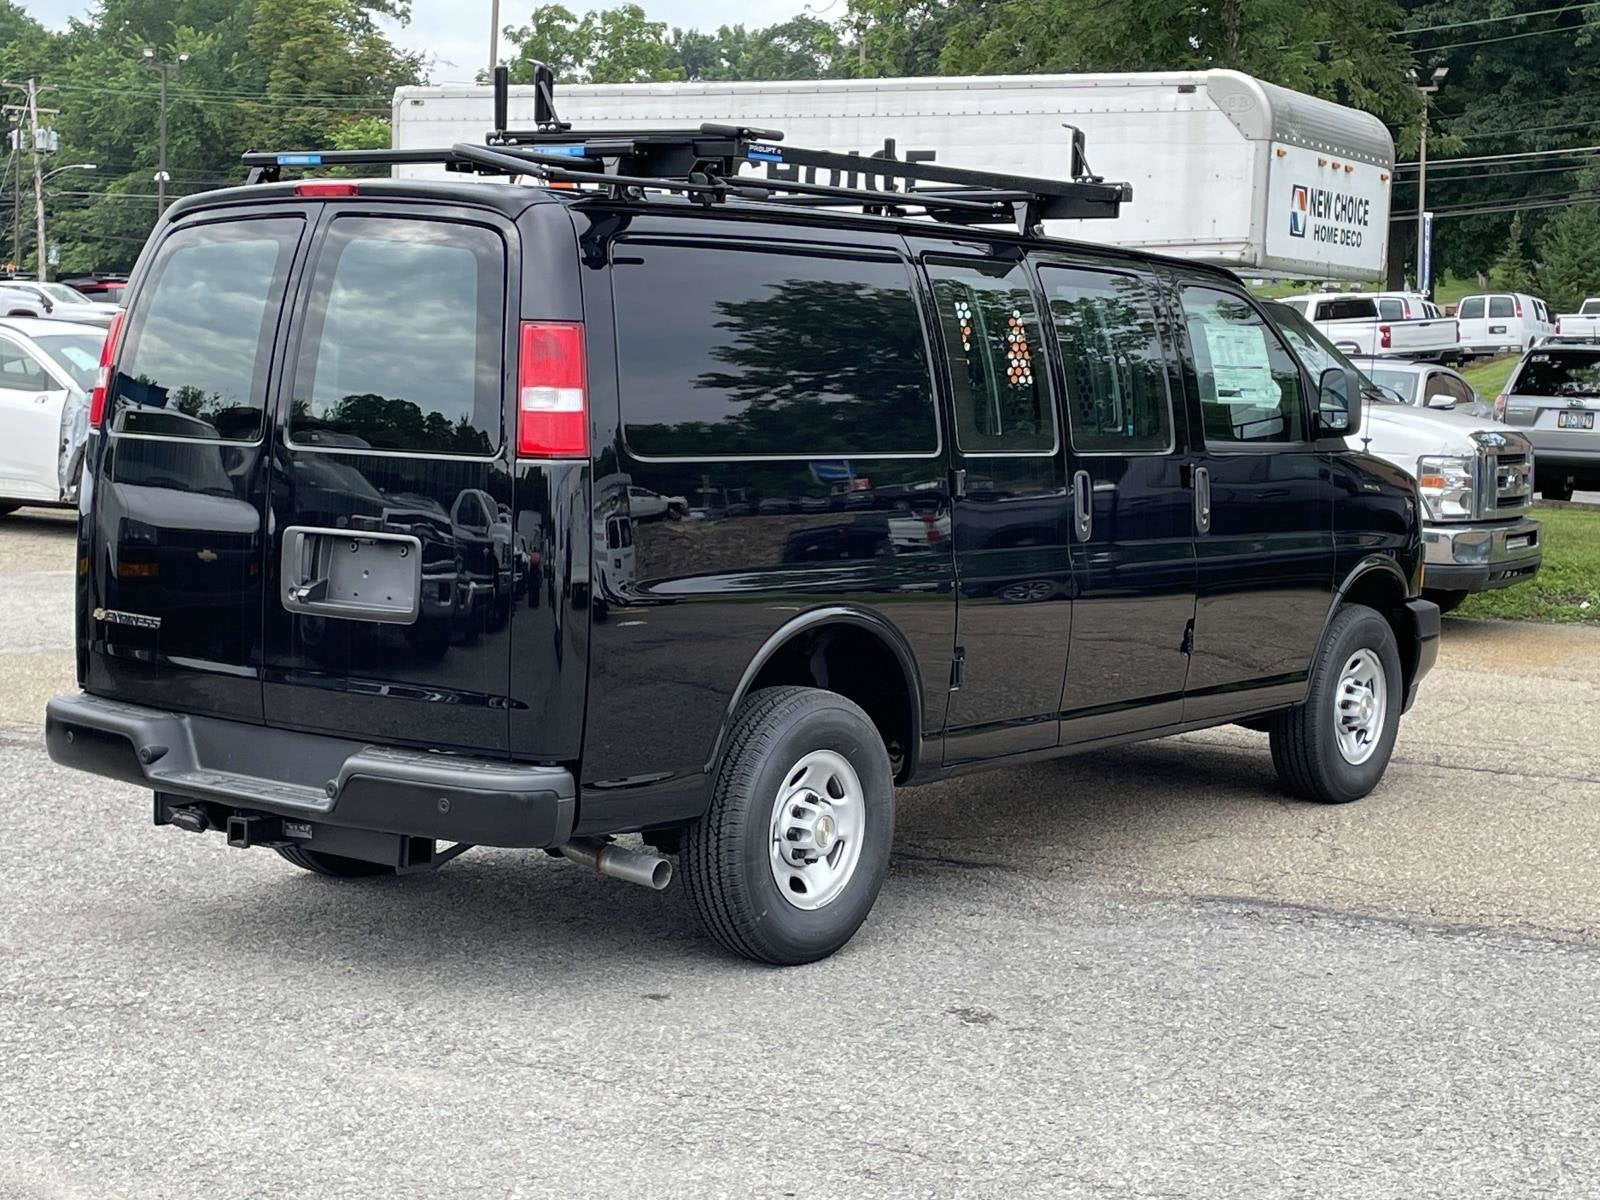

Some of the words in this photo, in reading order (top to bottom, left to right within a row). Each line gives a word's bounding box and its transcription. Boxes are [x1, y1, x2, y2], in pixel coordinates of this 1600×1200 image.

[1309, 187, 1333, 220] NEW
[1334, 192, 1370, 227] CHOICE
[1313, 223, 1339, 245] HOME
[1340, 228, 1363, 249] DECO
